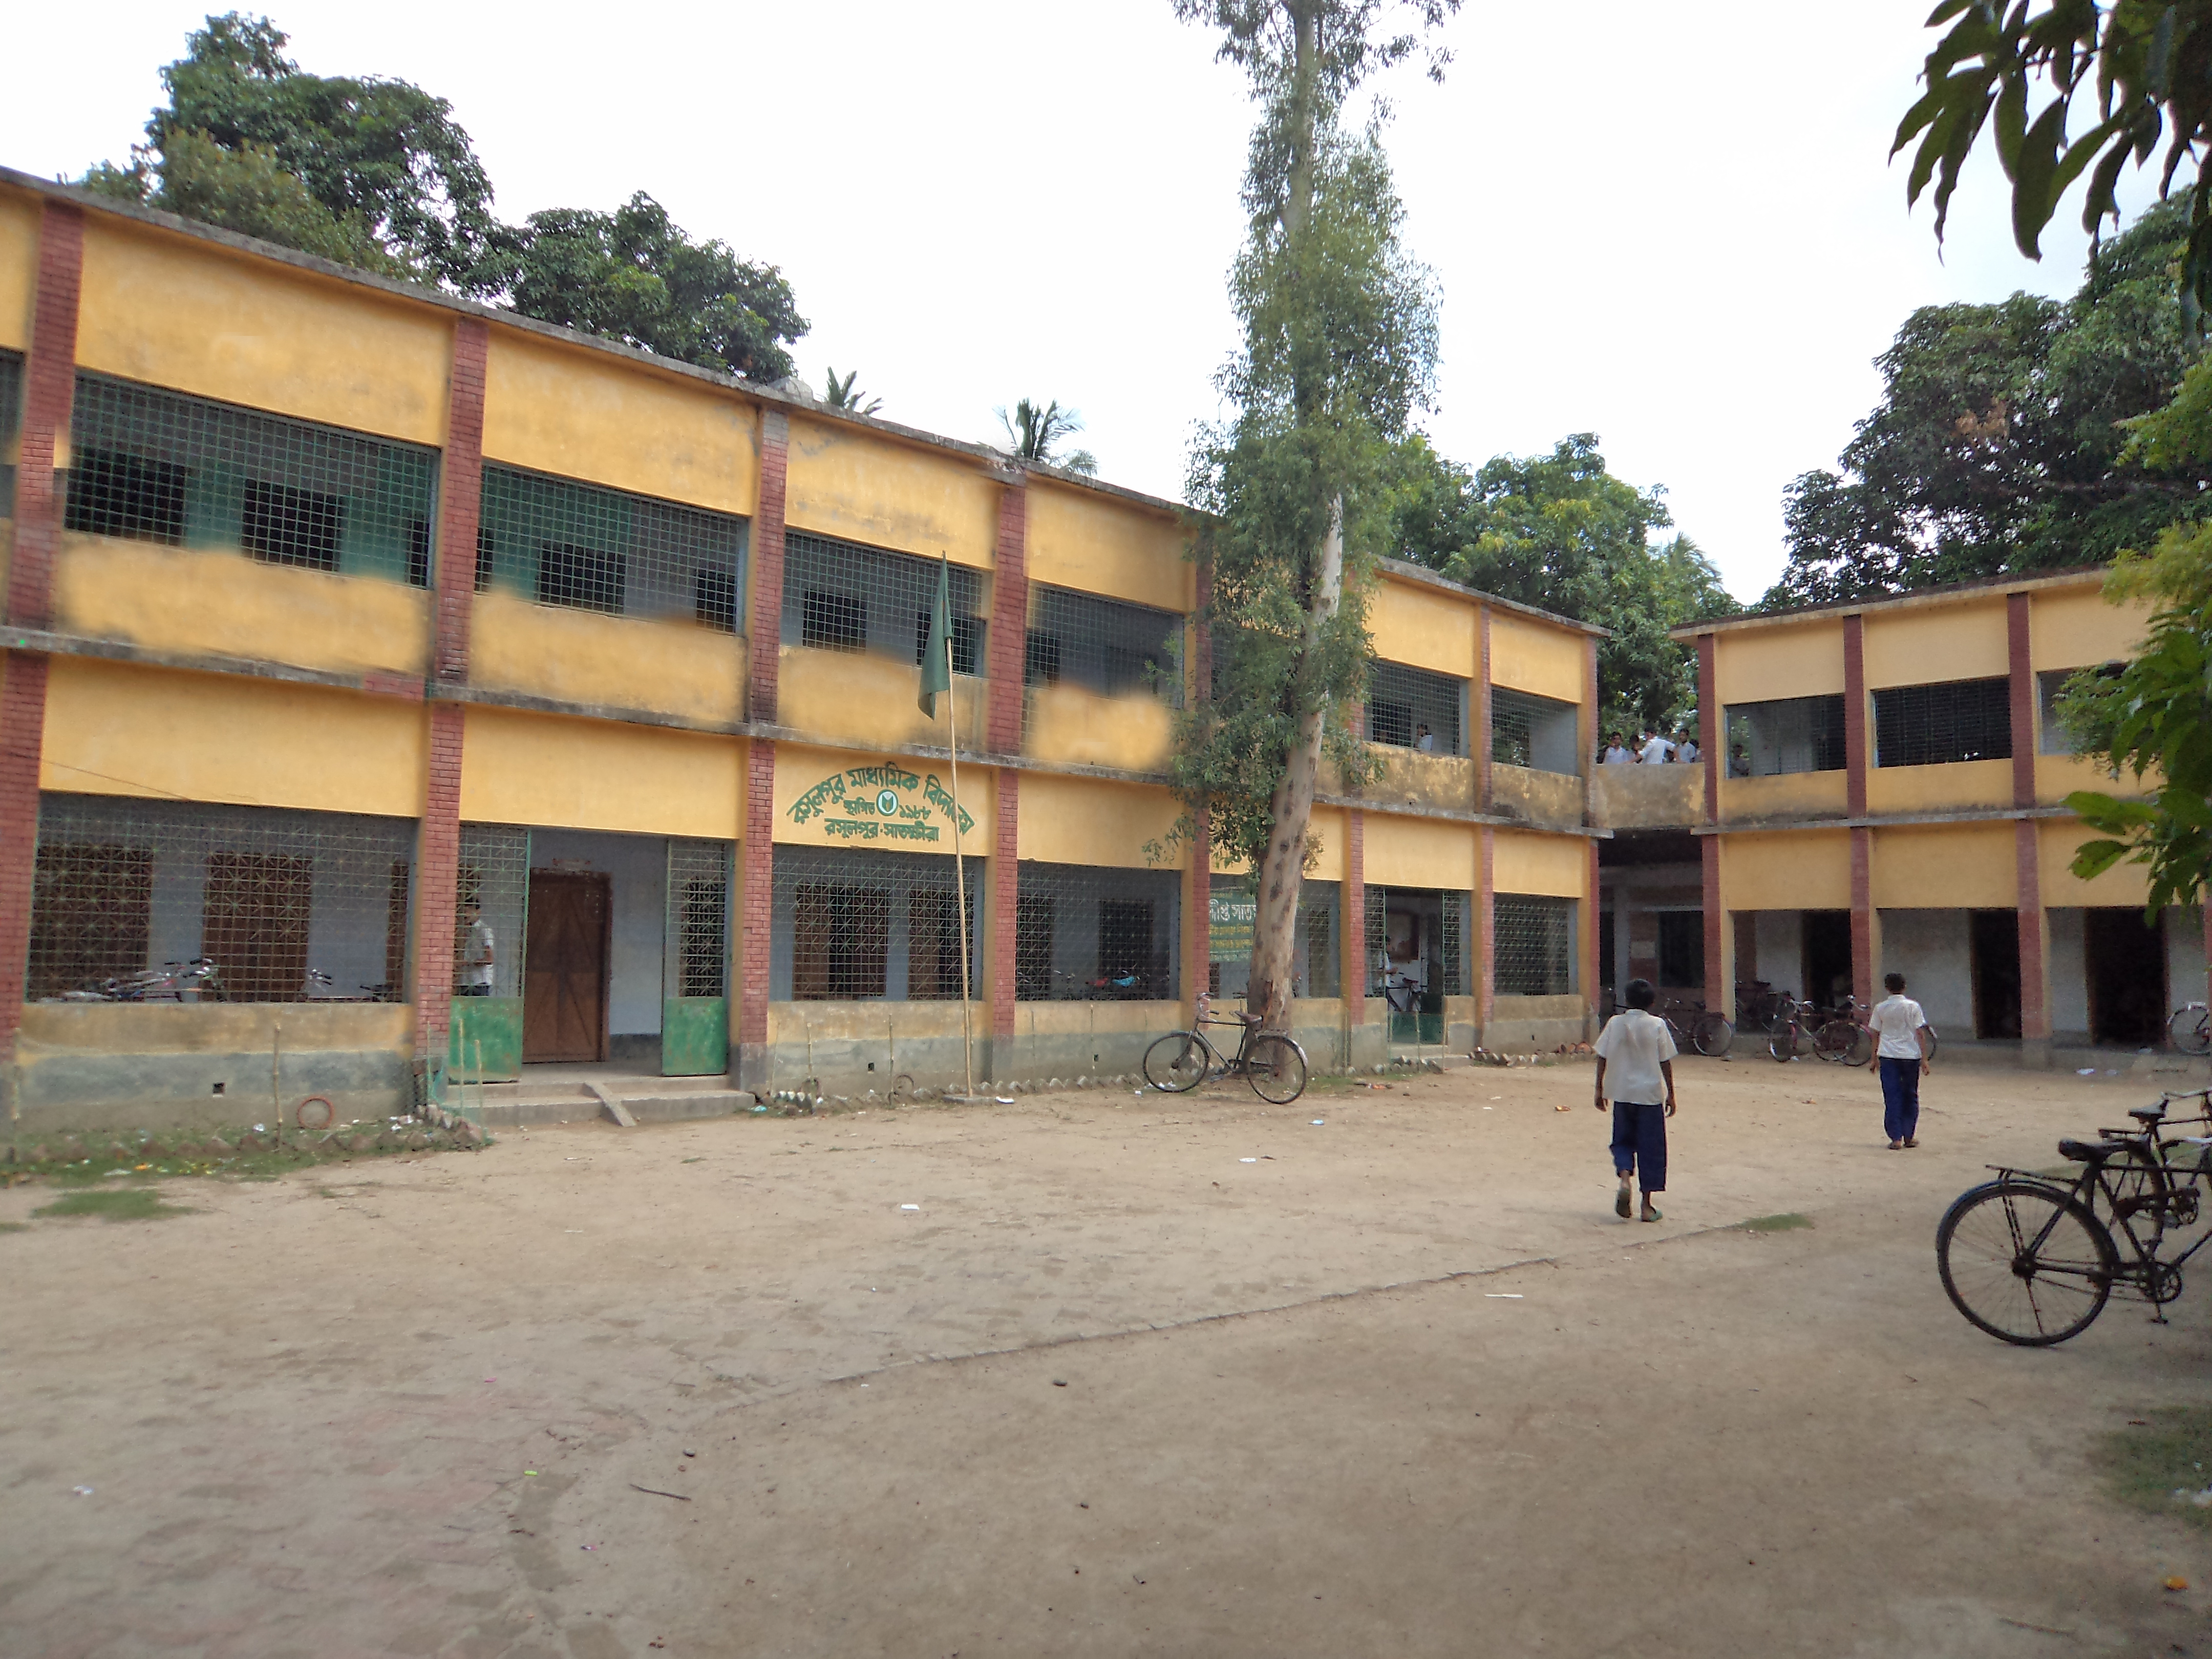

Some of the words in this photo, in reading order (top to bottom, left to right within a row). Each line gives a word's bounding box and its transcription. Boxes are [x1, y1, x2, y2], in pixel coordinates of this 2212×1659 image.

[786, 773, 846, 823] রসুলপুর
[846, 761, 920, 792] মাধ্যমিক
[900, 804, 931, 819] ১৯৮৮
